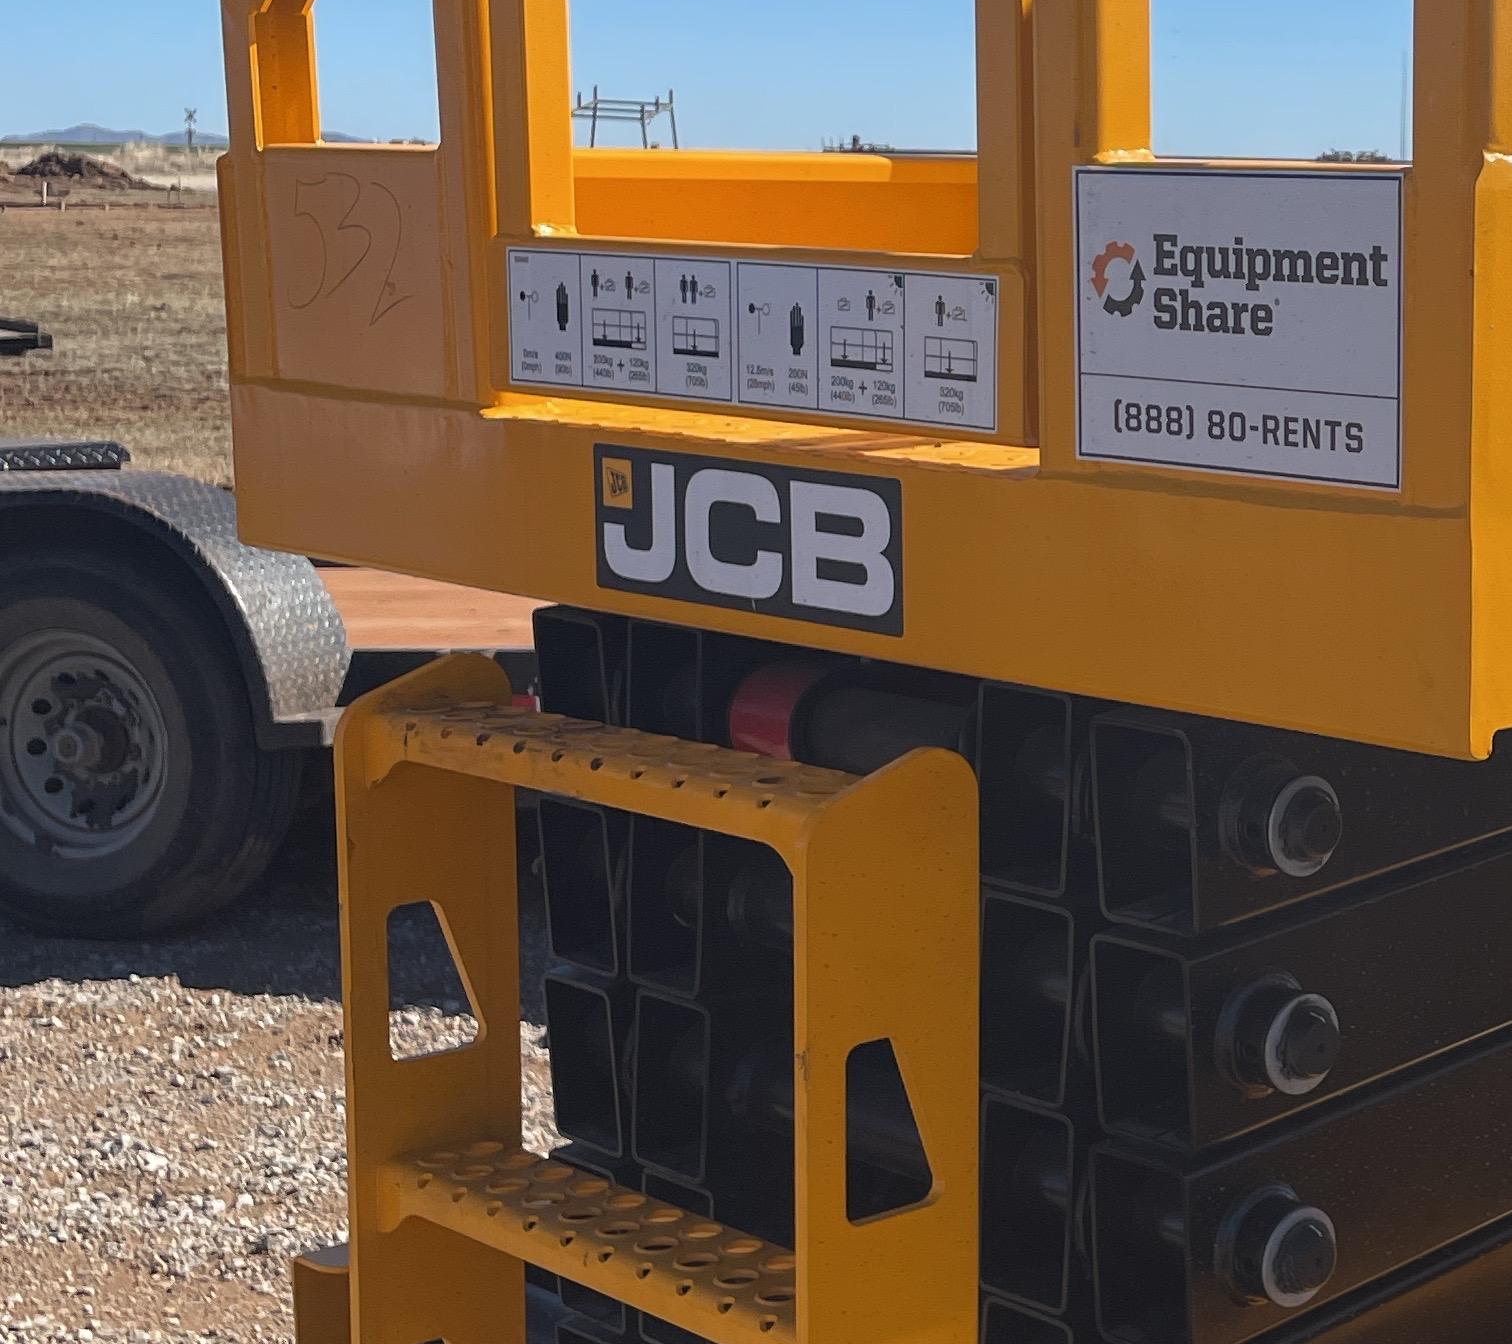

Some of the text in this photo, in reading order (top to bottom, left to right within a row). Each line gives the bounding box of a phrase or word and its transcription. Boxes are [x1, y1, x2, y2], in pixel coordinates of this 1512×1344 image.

[1152, 233, 1389, 292] Equipment
[1152, 287, 1274, 336] Share
[1113, 398, 1364, 453] (888) 80-RENTS
[603, 462, 895, 617] JCB
